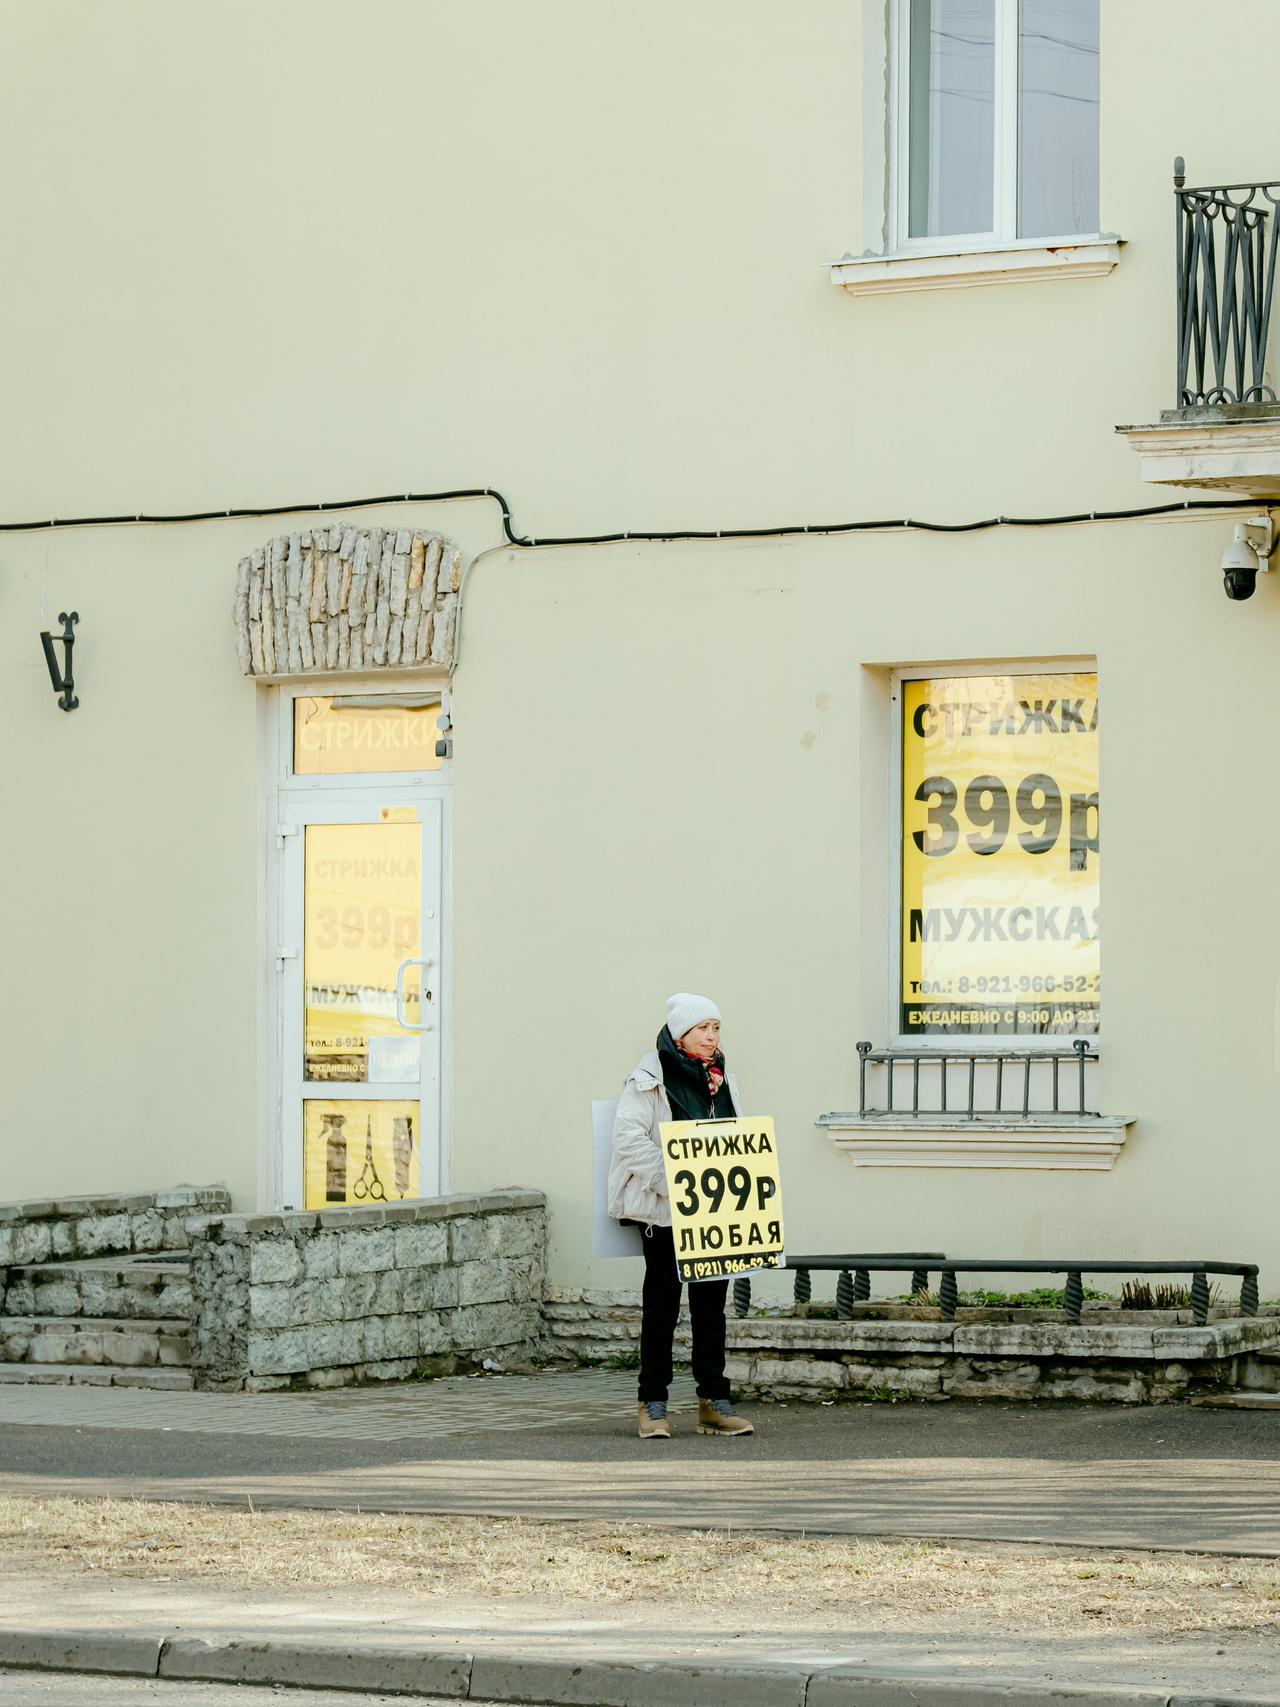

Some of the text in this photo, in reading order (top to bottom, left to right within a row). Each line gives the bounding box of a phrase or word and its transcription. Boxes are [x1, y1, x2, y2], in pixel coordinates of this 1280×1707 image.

[912, 773, 1100, 872] 399р
[314, 857, 418, 879] СТРИЖКА
[314, 905, 418, 959] 399р
[910, 980, 952, 994] тел.:
[909, 1010, 1000, 1026] ЕЖЕДНЕВНО
[1004, 1010, 1014, 1024] С
[1017, 1010, 1049, 1024] 9:00
[1052, 1010, 1074, 1025] ДО
[309, 1063, 358, 1073] ЕЖЕДНЕВНО
[667, 1133, 773, 1160] СТРИЖКА
[679, 1221, 781, 1252] ЛЮБАЯ
[683, 1263, 692, 1278] 8
[694, 1261, 722, 1279] (921)
